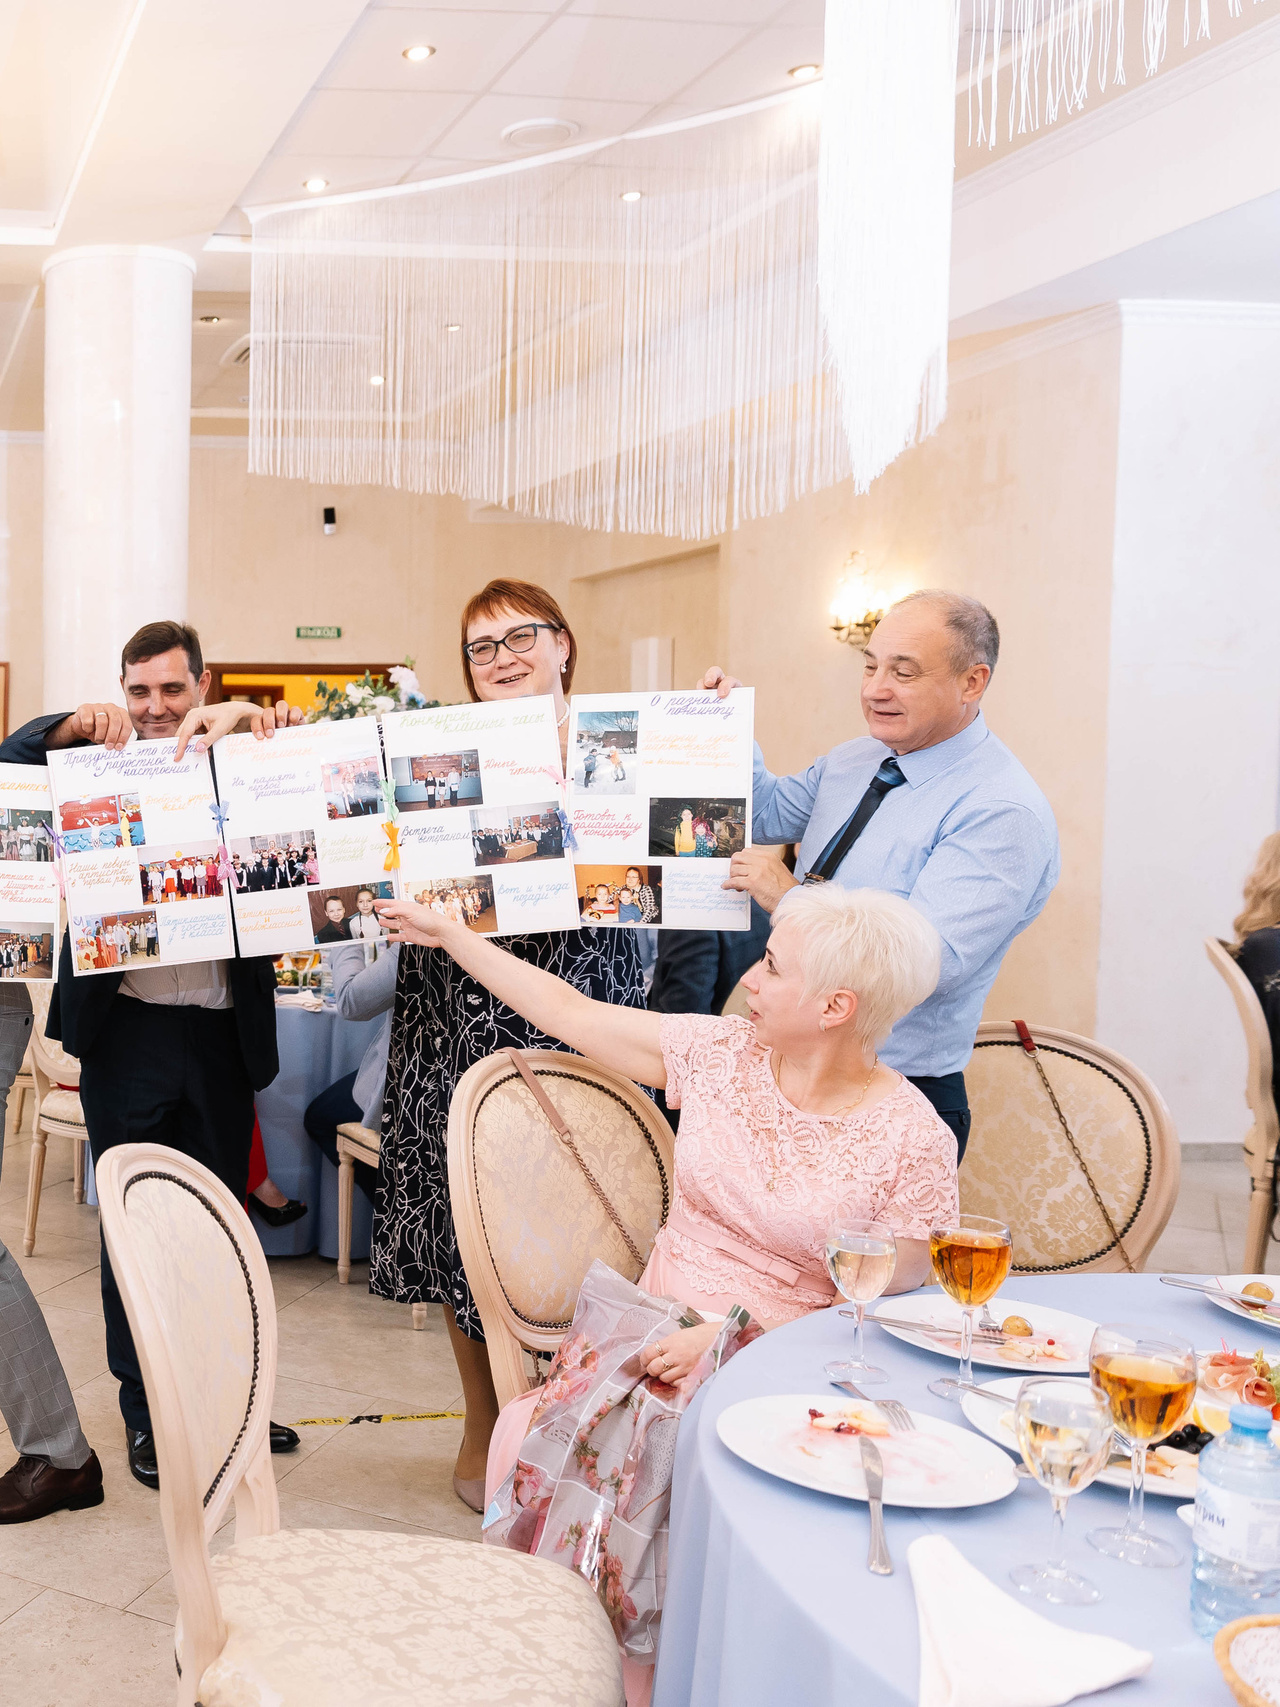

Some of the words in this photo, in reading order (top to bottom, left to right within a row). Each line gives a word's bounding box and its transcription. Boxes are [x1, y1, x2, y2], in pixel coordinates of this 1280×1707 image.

[650, 694, 661, 707] О
[135, 746, 158, 757] это
[93, 757, 167, 778] радостное
[401, 825, 445, 837] Встреча
[573, 821, 643, 835] домашнему
[418, 832, 471, 846] ветераном
[582, 829, 633, 841] концерту
[497, 884, 521, 896] Вот
[545, 882, 570, 898] года
